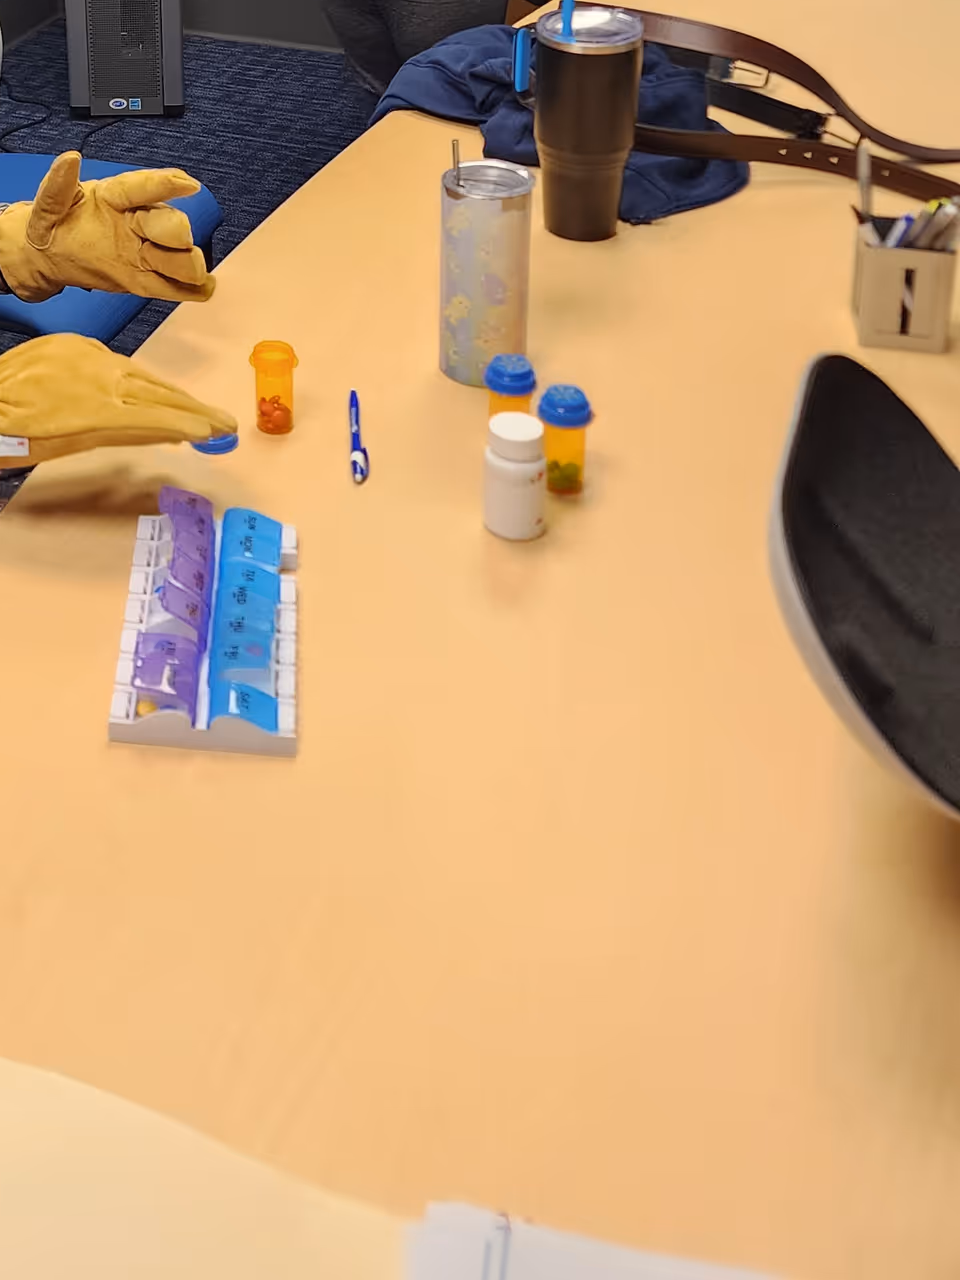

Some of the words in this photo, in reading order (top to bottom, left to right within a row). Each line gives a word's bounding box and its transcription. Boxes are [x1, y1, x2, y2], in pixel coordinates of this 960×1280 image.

[247, 516, 258, 530] SUN
[243, 535, 254, 553] MON
[236, 586, 248, 605] WED
[233, 616, 245, 633] THU
[239, 692, 250, 711] SAT
